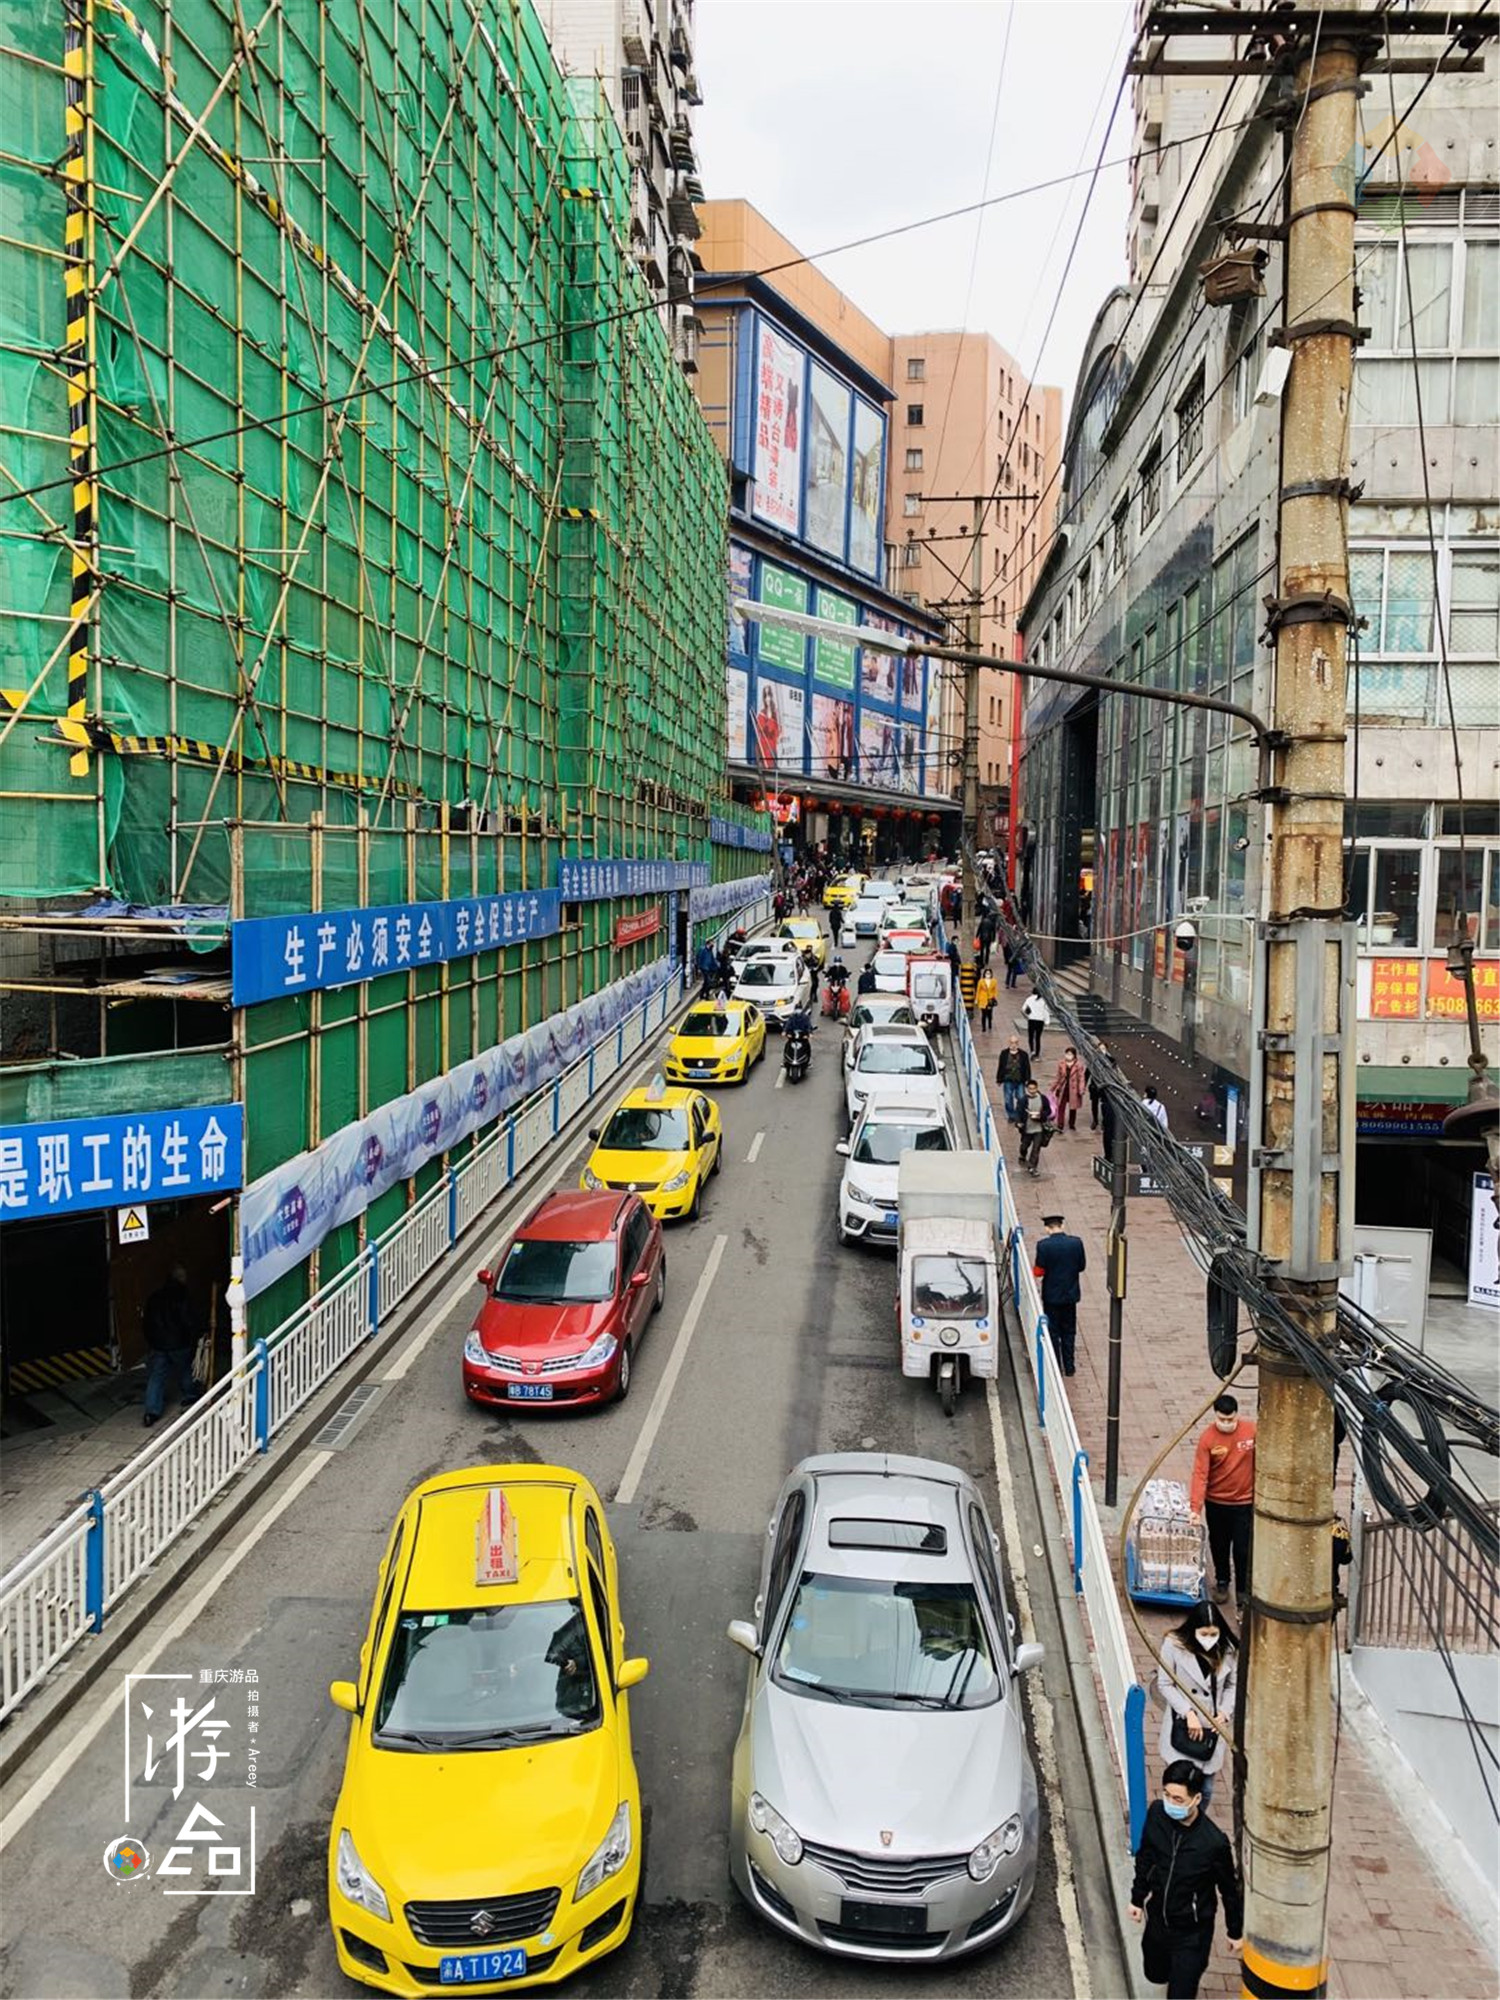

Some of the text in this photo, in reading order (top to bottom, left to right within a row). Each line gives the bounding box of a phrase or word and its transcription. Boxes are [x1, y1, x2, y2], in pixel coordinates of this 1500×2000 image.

[0, 1116, 228, 1208] 是职工的生命
[485, 1569, 510, 1578] TAXI
